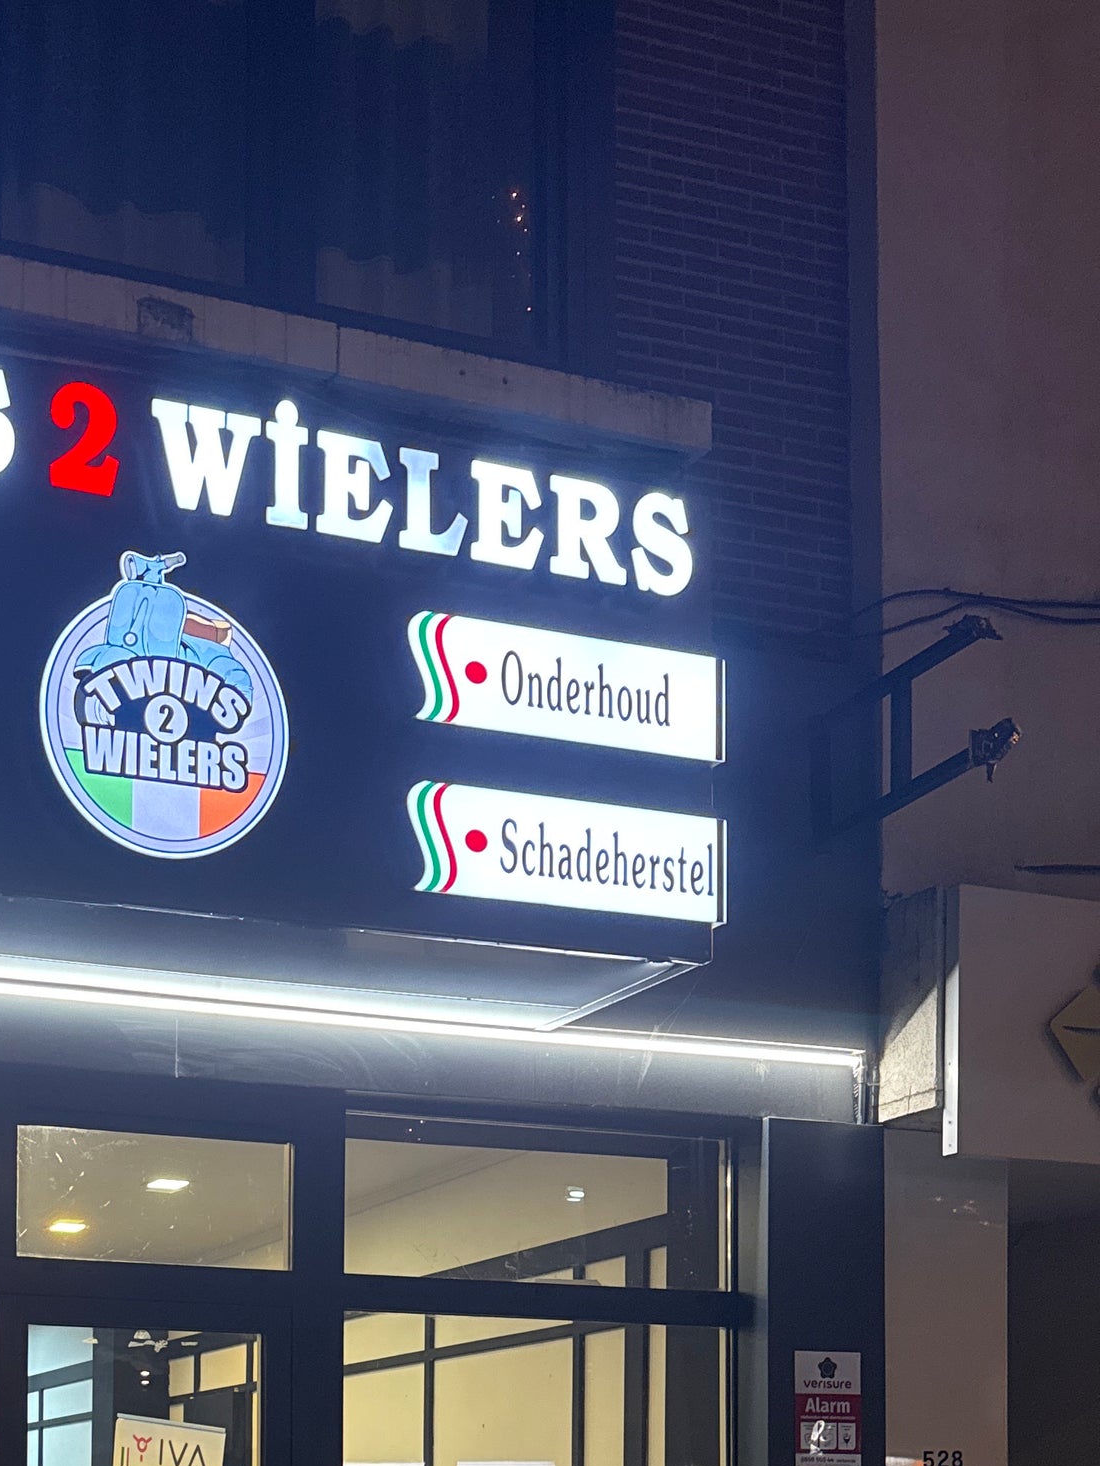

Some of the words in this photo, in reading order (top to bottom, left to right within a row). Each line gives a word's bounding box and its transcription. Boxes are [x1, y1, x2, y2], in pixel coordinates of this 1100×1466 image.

[48, 380, 120, 497] 2
[84, 660, 248, 729] TWINS
[158, 704, 175, 734] 2
[500, 650, 672, 728] Onderhoud
[85, 725, 247, 790] WIELERS
[500, 818, 715, 898] Schadeherstel
[803, 1378, 852, 1389] verisure
[805, 1397, 851, 1413] Alarm
